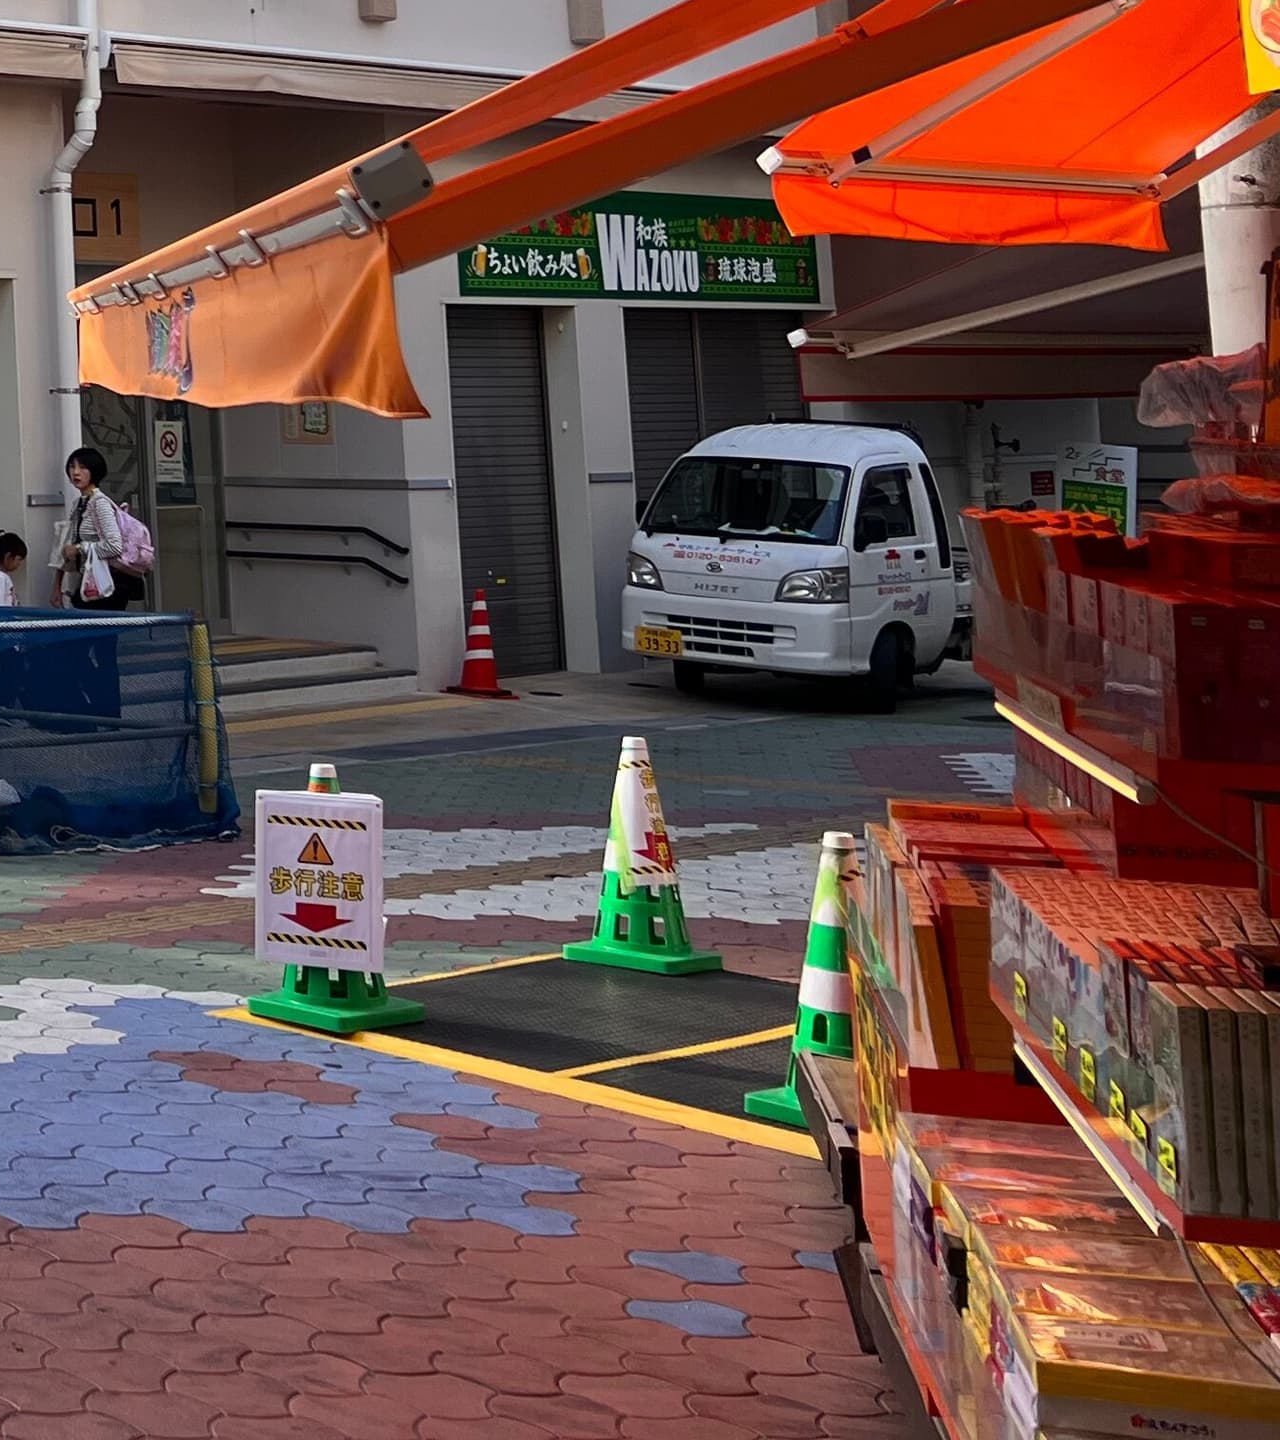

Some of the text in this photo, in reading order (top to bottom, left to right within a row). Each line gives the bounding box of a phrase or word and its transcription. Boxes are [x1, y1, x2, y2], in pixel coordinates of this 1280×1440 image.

[72, 198, 122, 237] 口1
[636, 215, 669, 249] 和族
[487, 246, 578, 279] ちょい飲み処
[595, 212, 700, 293] WAZOKU
[718, 256, 777, 283] 琉球泡盛
[694, 582, 739, 594] HIJET
[269, 866, 365, 901] 歩行注意
